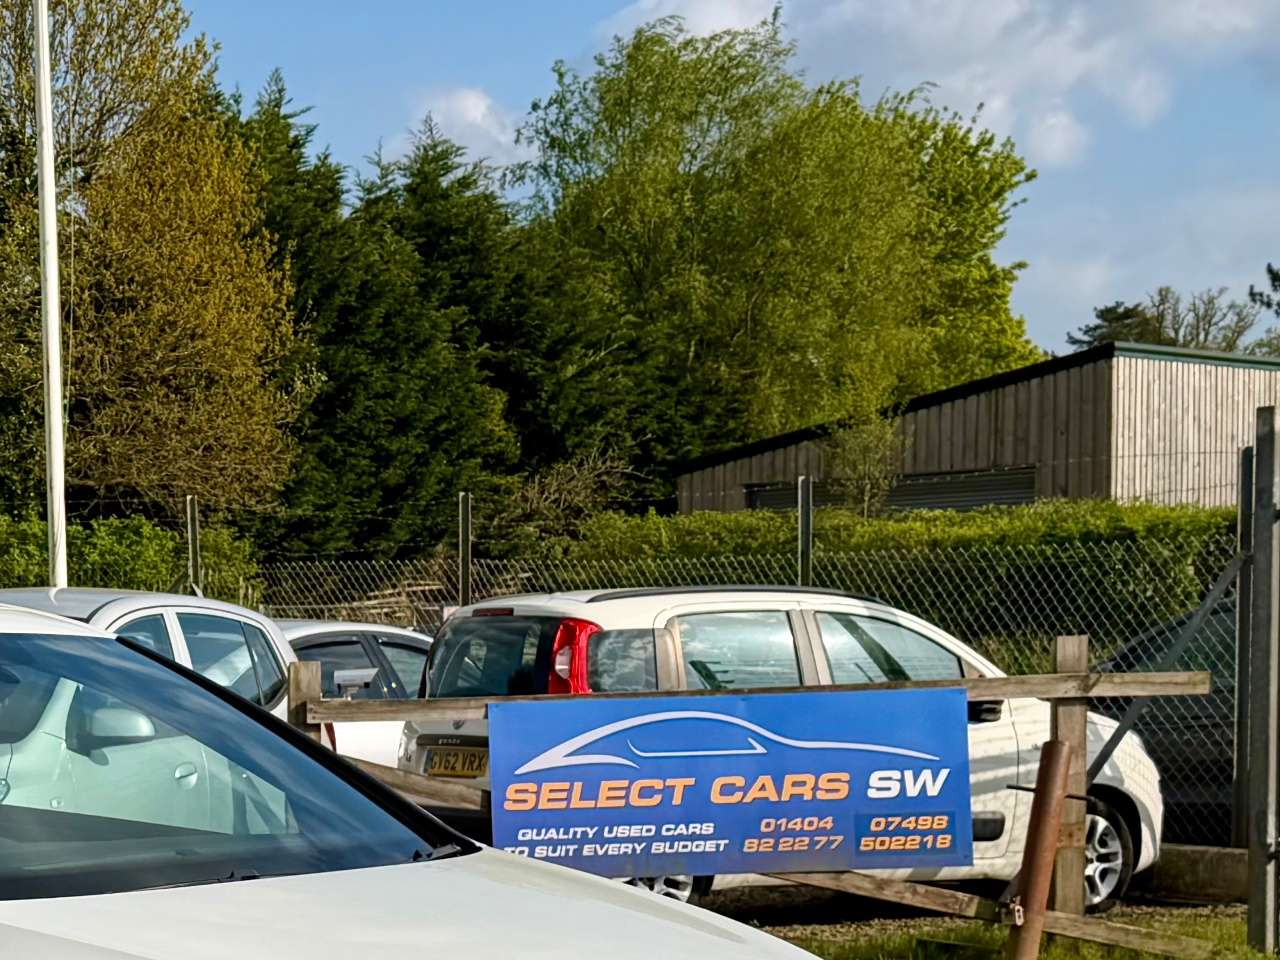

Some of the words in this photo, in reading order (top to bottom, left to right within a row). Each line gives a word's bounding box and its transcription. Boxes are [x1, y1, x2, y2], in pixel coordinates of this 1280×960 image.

[462, 751, 488, 772] VRX
[503, 777, 696, 811] SELECT
[710, 772, 851, 804] CARS
[867, 768, 951, 799] SW
[517, 826, 599, 841] QUALITY
[604, 824, 656, 838] USED
[661, 822, 715, 836] CARS
[760, 815, 835, 833] 01404
[870, 815, 949, 832] 07498
[534, 845, 578, 858] SUIT
[582, 842, 646, 856] EVERY
[650, 839, 730, 854] BUDGET
[858, 834, 952, 852] 502218
